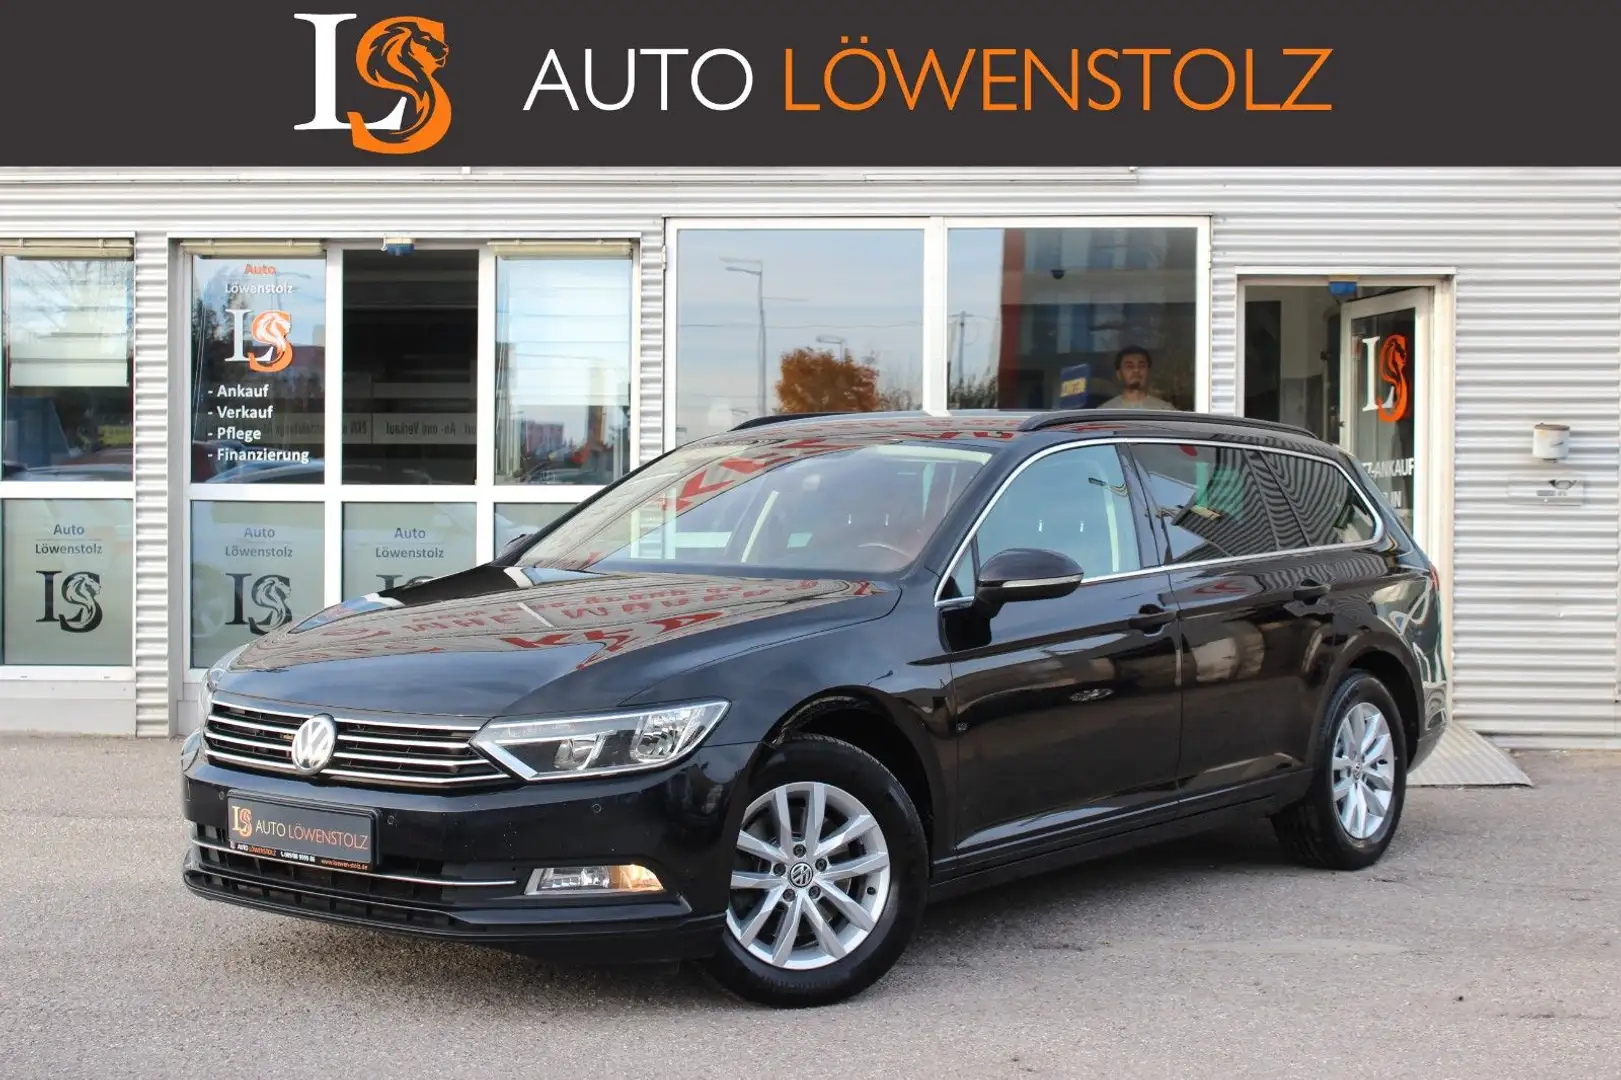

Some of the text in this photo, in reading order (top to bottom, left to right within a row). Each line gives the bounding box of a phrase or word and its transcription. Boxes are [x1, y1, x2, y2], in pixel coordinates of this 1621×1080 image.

[244, 263, 277, 275] Auto
[225, 281, 293, 295] Löwenstolz
[217, 384, 270, 398] Ankauf
[217, 406, 273, 419] Verkauf
[217, 427, 262, 442] Pflege
[217, 448, 310, 464] Finanzierung
[53, 524, 85, 535] Auto
[244, 527, 276, 538] Auto
[394, 527, 426, 539] Auto
[36, 543, 103, 555] Löwenstolz
[225, 545, 293, 557] Löwenstolz
[376, 547, 444, 558] Löwenstolz
[255, 819, 369, 850] AUTO LÖWENSTOLZ
